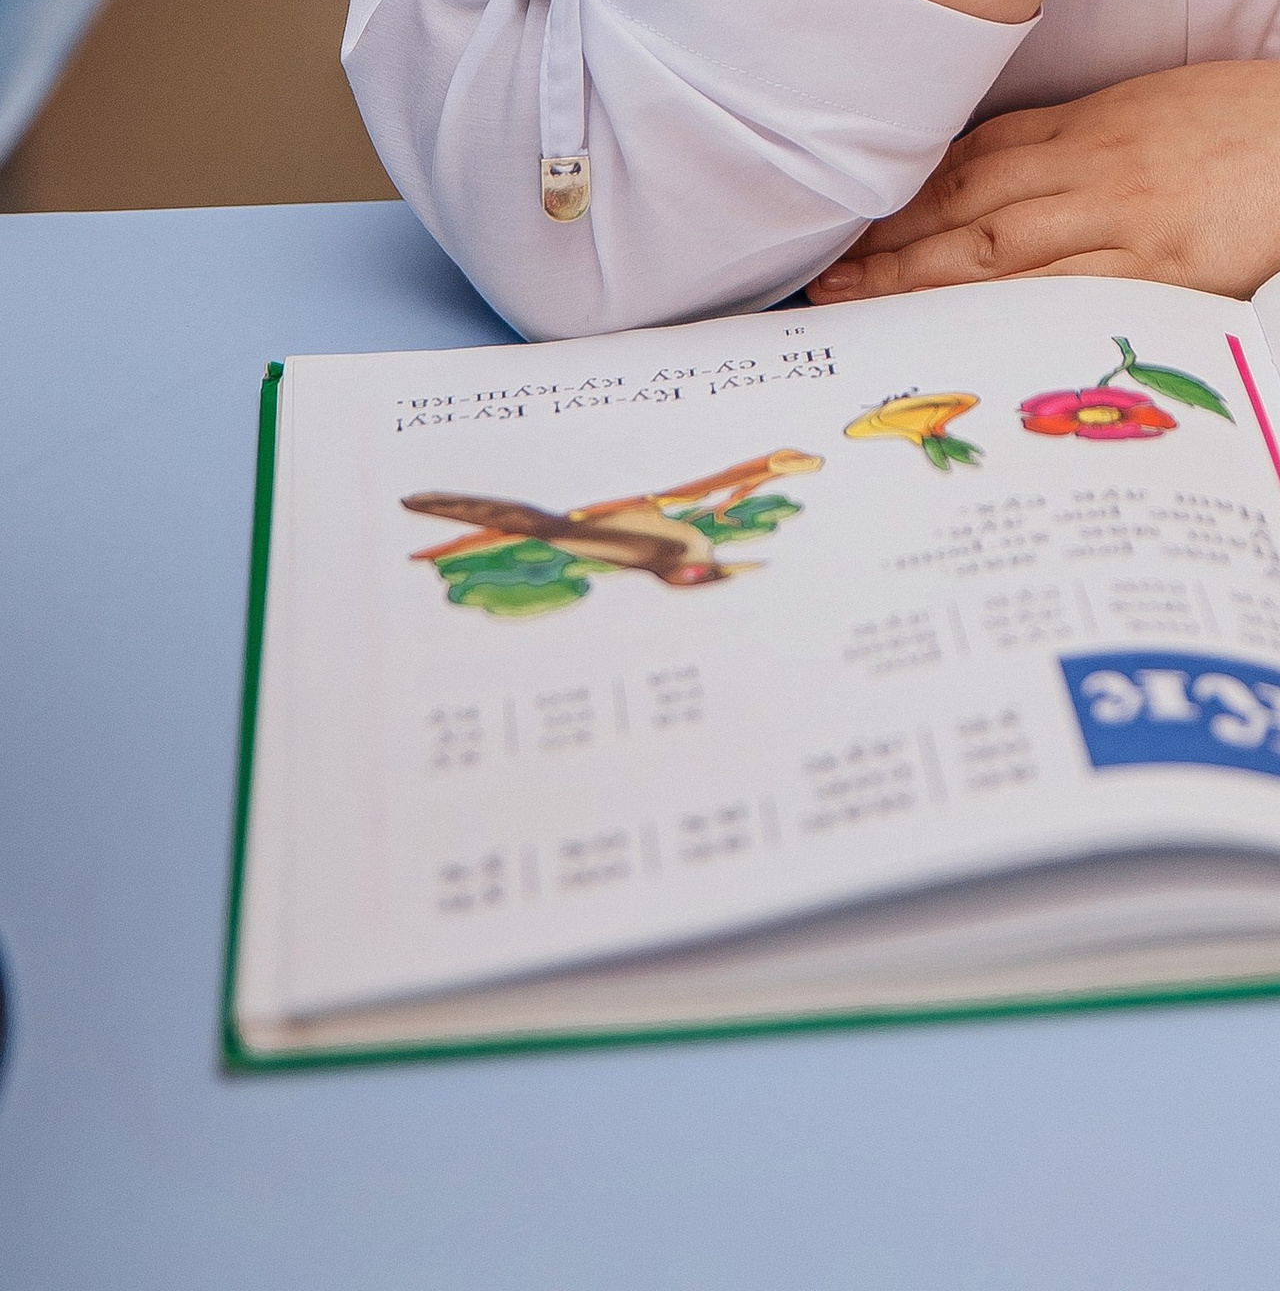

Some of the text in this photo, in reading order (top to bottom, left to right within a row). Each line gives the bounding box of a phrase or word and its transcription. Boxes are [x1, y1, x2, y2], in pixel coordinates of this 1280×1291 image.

[782, 326, 805, 336] 31
[395, 362, 836, 432] Ку-ку! Ку-ку! Ку-ку!
[396, 346, 834, 409] На су-ку ку-куш-ка.
